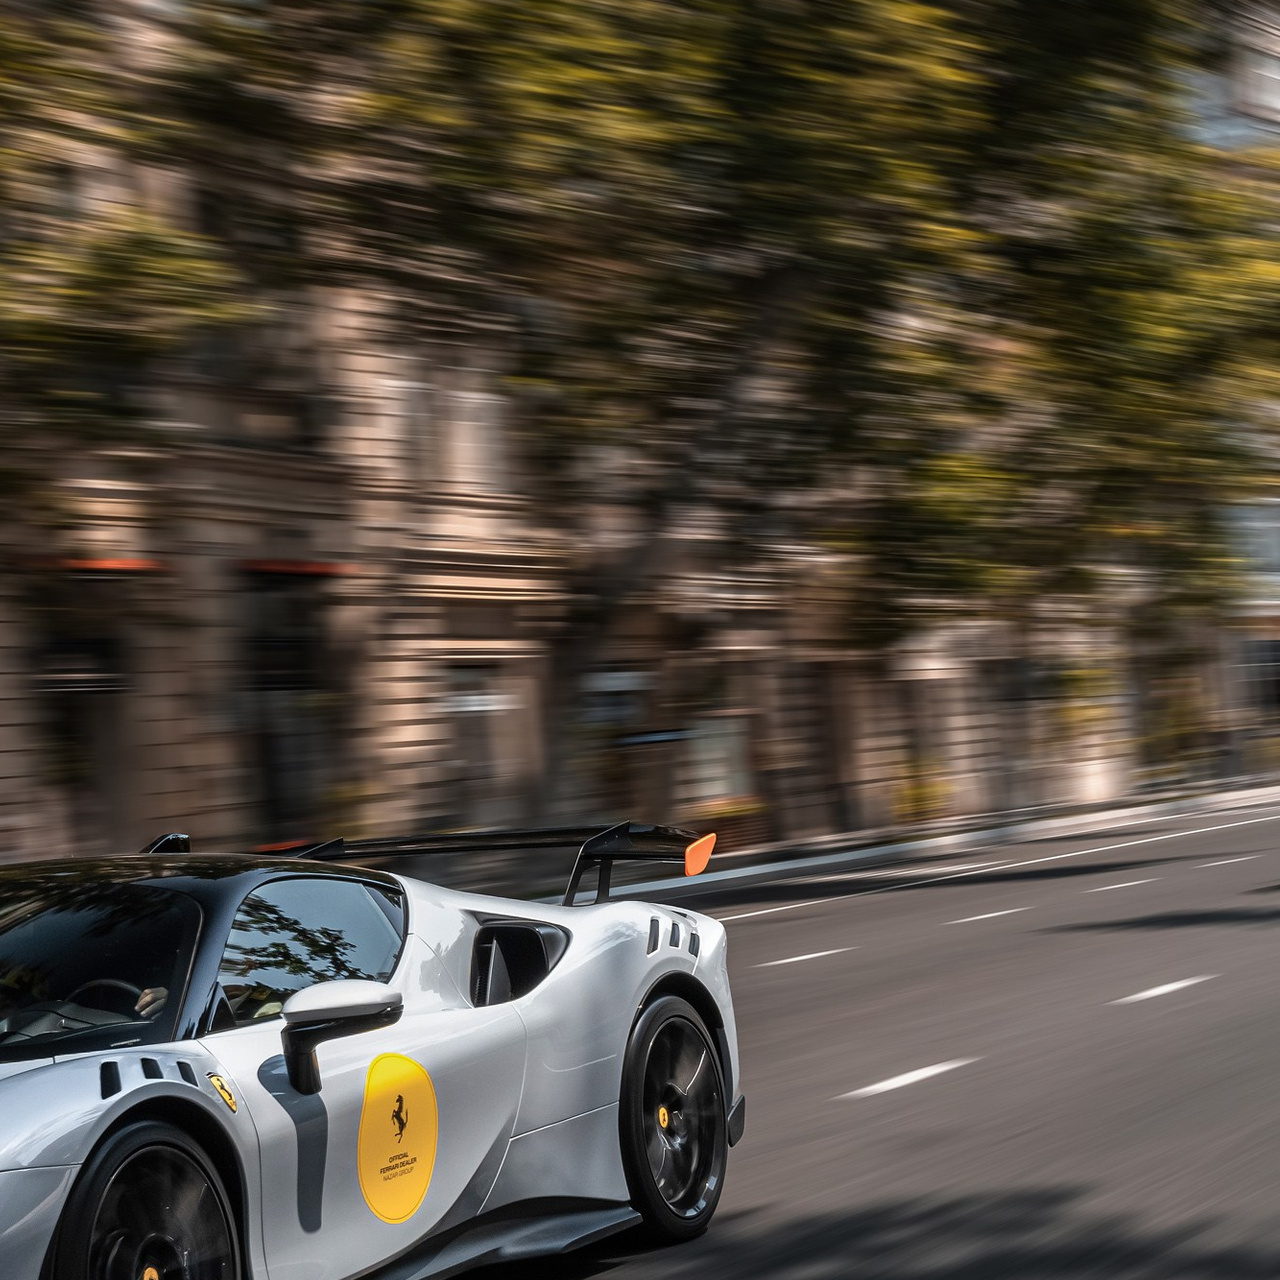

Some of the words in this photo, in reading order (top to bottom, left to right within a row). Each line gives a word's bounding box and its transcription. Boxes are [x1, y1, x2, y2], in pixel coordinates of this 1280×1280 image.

[388, 1152, 409, 1163] OFFICIAL
[380, 1163, 400, 1174] FERRARI
[400, 1157, 417, 1168] DEALER
